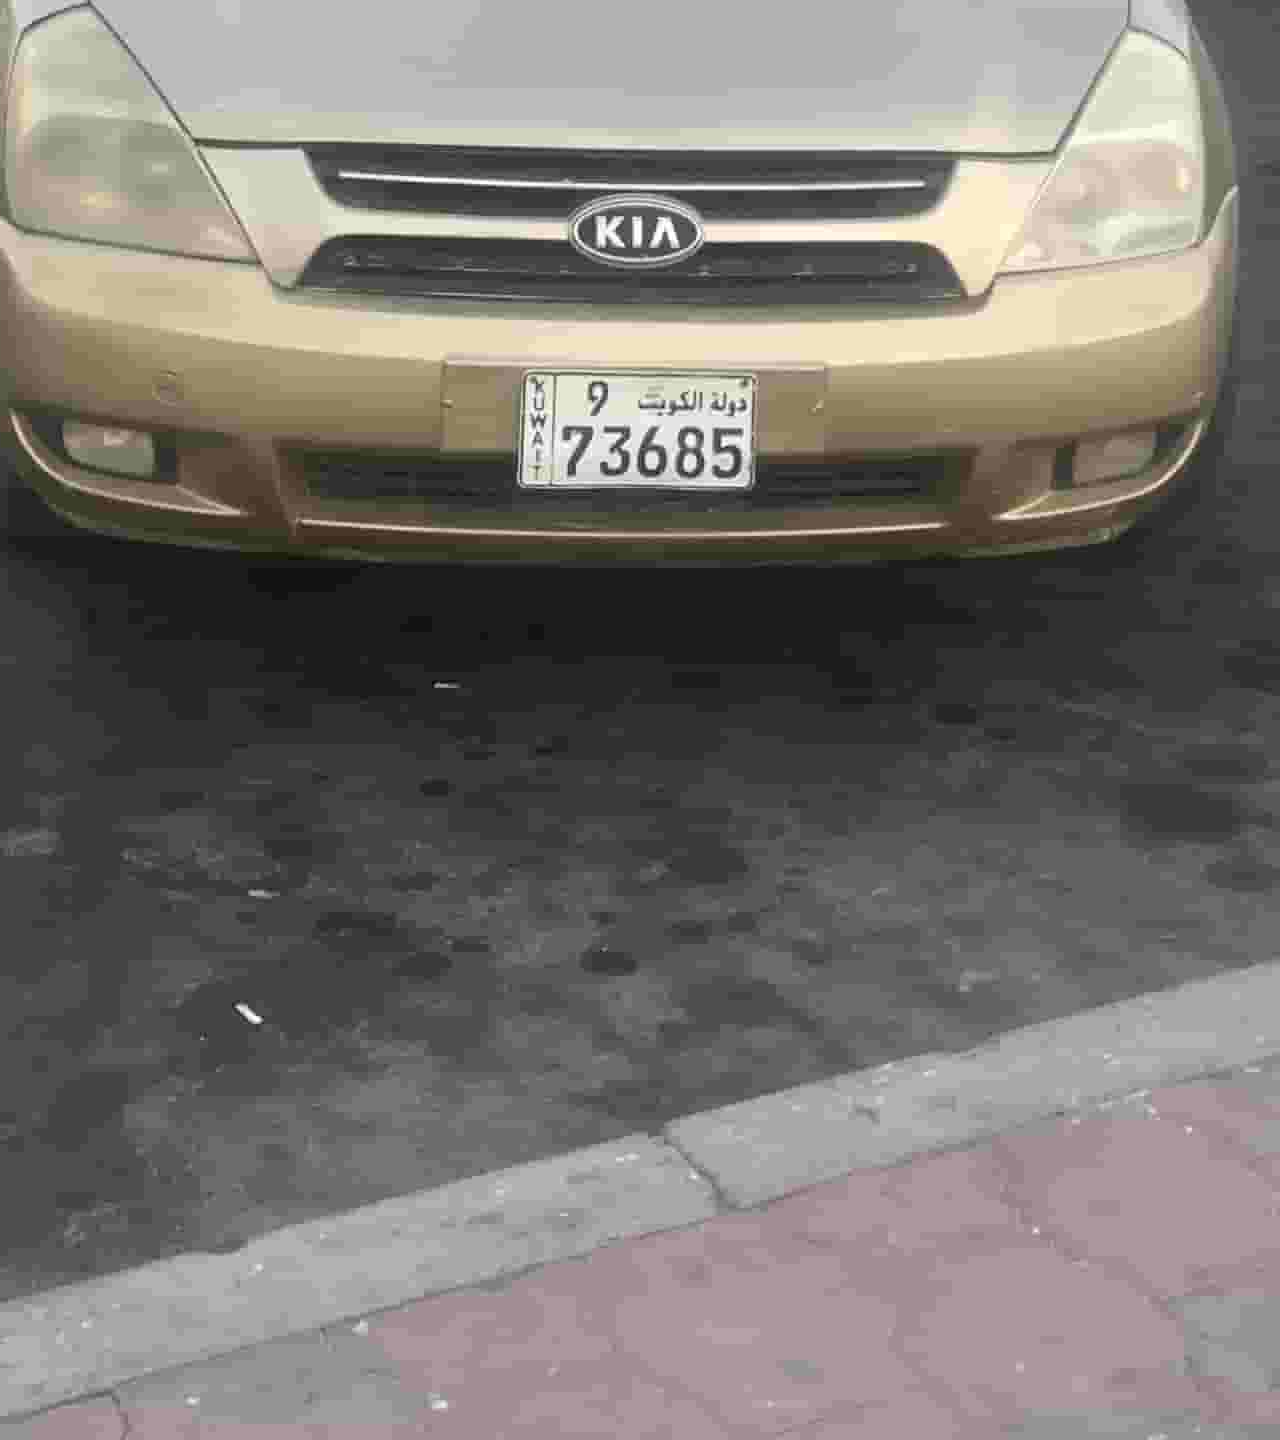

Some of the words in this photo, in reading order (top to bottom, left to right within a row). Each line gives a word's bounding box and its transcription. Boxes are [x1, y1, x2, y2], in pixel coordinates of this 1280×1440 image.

[594, 215, 681, 249] KIA
[588, 381, 609, 417] 9
[638, 390, 704, 417] الكويت
[710, 391, 748, 417] دولة
[529, 380, 546, 480] KUWAIT
[562, 425, 744, 478] 73685
